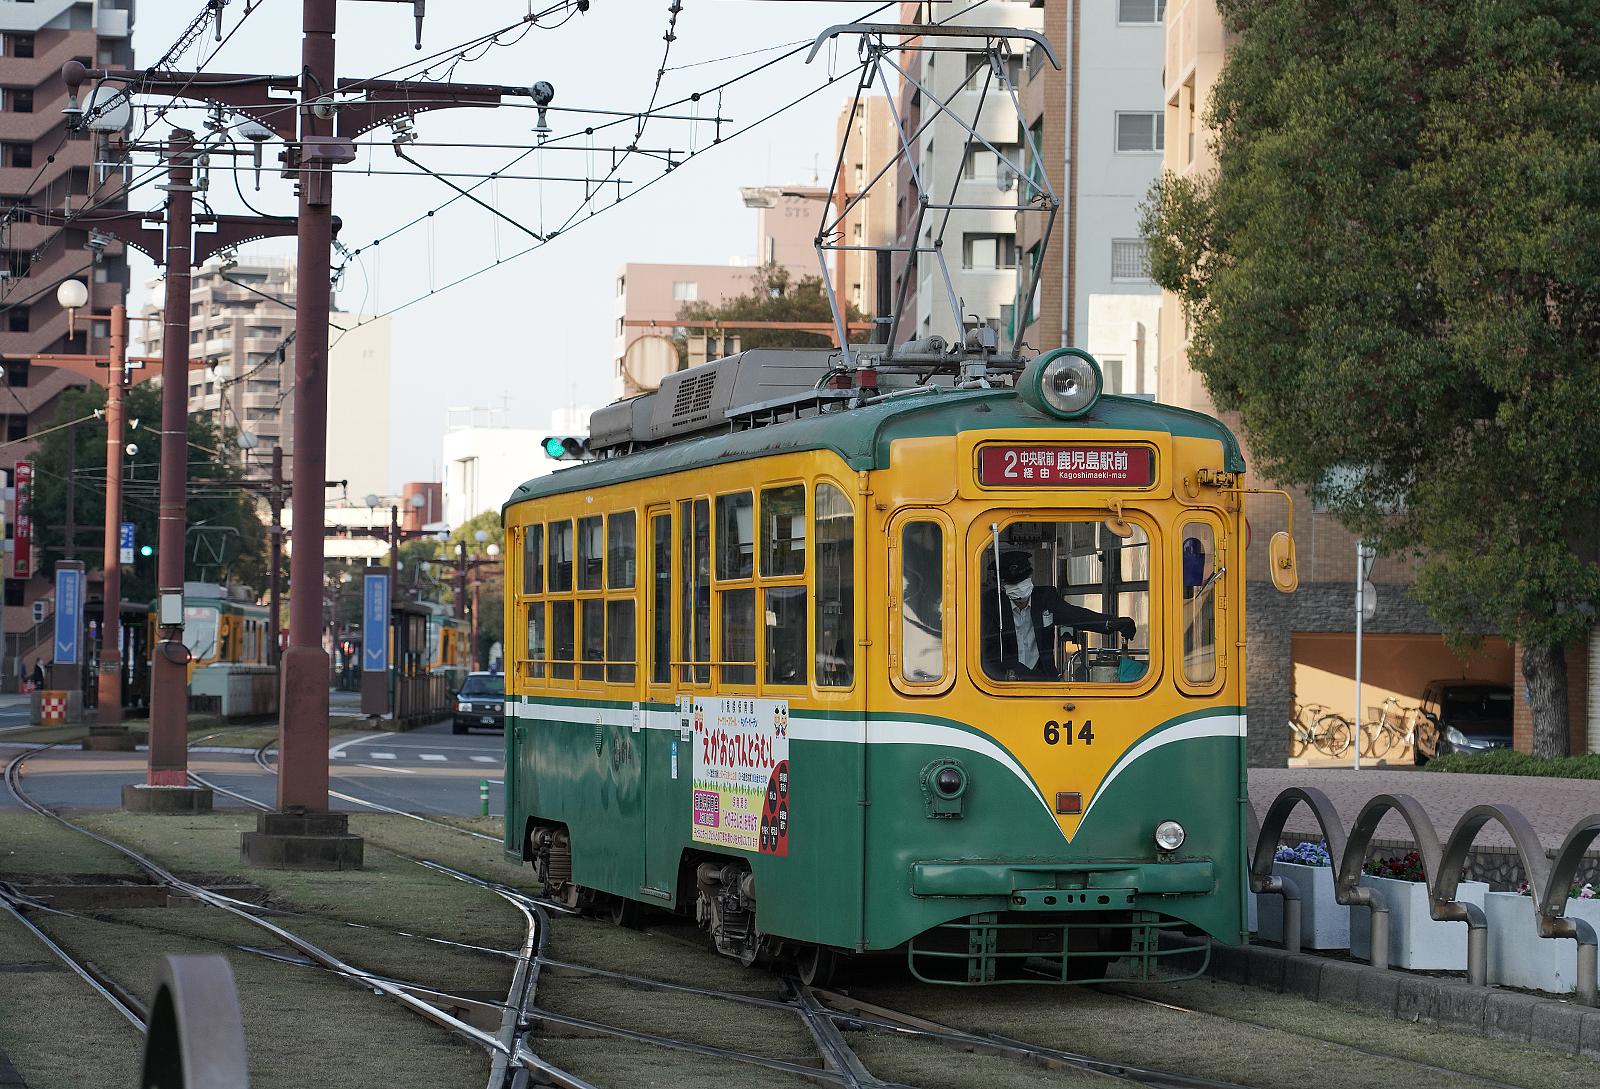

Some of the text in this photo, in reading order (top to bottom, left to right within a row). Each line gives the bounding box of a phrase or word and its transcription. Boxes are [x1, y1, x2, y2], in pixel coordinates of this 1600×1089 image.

[1004, 450, 1018, 478] 2
[1020, 451, 1055, 466] 中央駅前
[1056, 451, 1128, 470] 鹿児島駅前
[1023, 467, 1050, 479] 経由
[1059, 471, 1127, 480] Kagoshimaeki-mae
[1043, 720, 1095, 746] 614
[702, 727, 776, 769] えがおのてんとうむし
